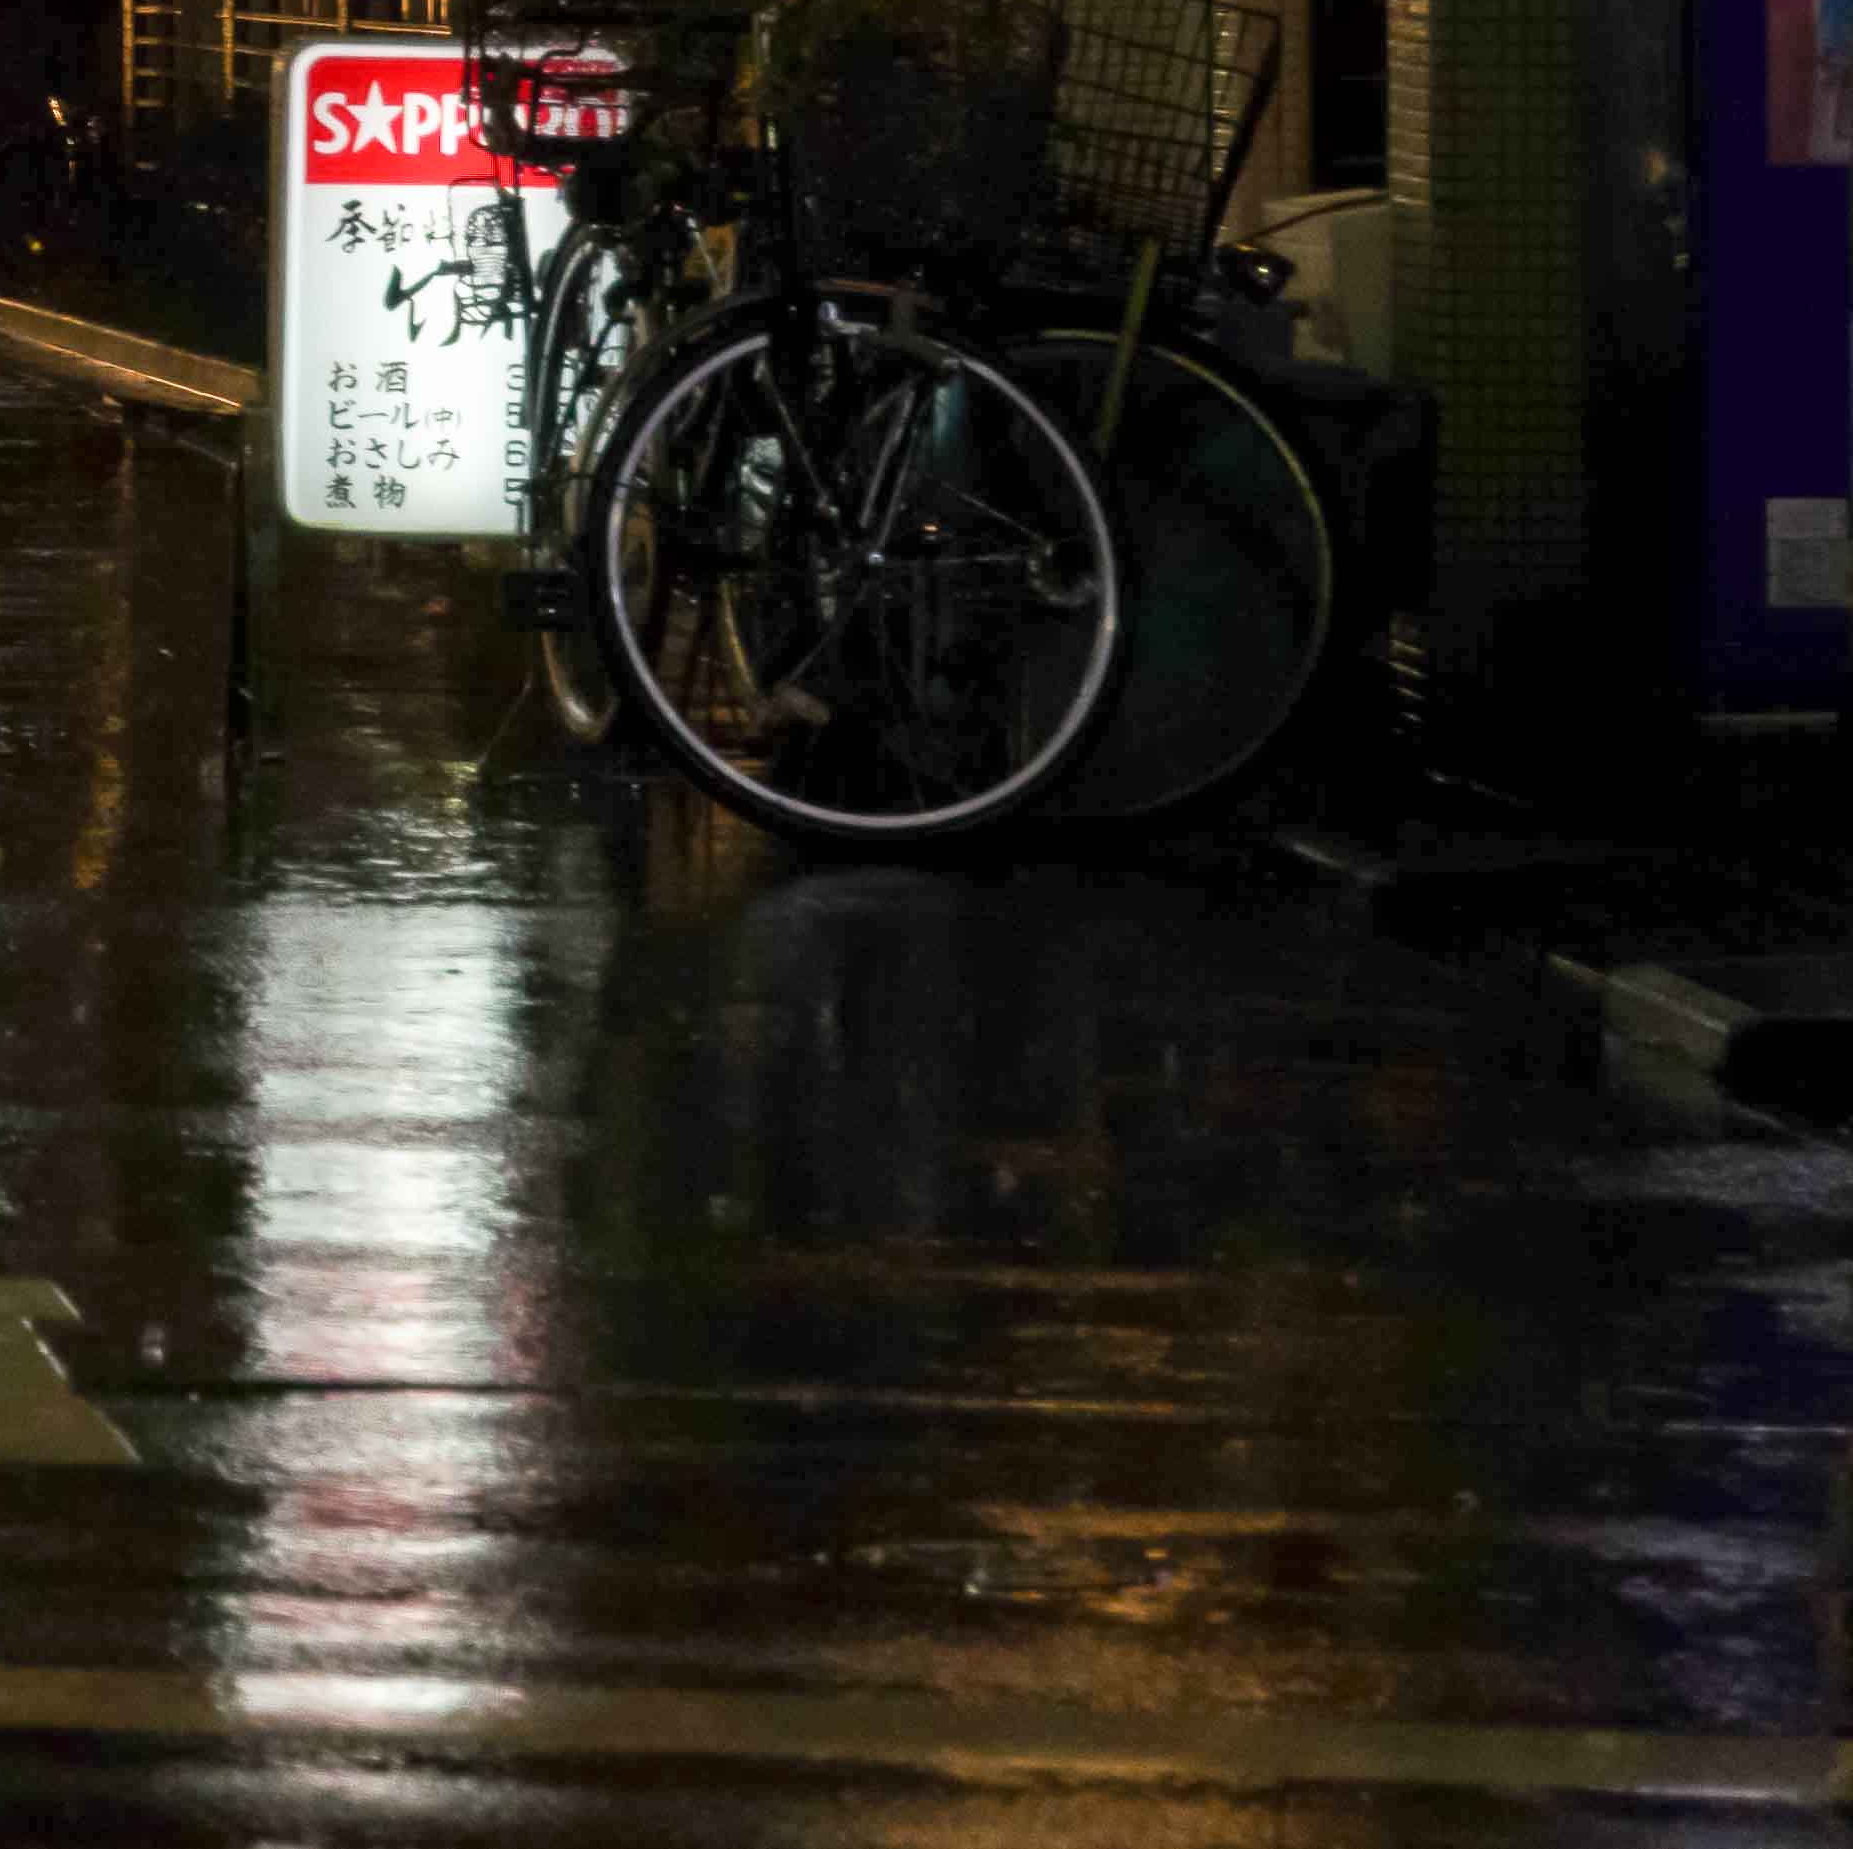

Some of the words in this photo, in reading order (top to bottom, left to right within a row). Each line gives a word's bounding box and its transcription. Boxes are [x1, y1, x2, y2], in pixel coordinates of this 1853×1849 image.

[327, 362, 409, 394] お酒
[327, 439, 461, 471] おさしみ
[325, 477, 407, 510] 煮物
